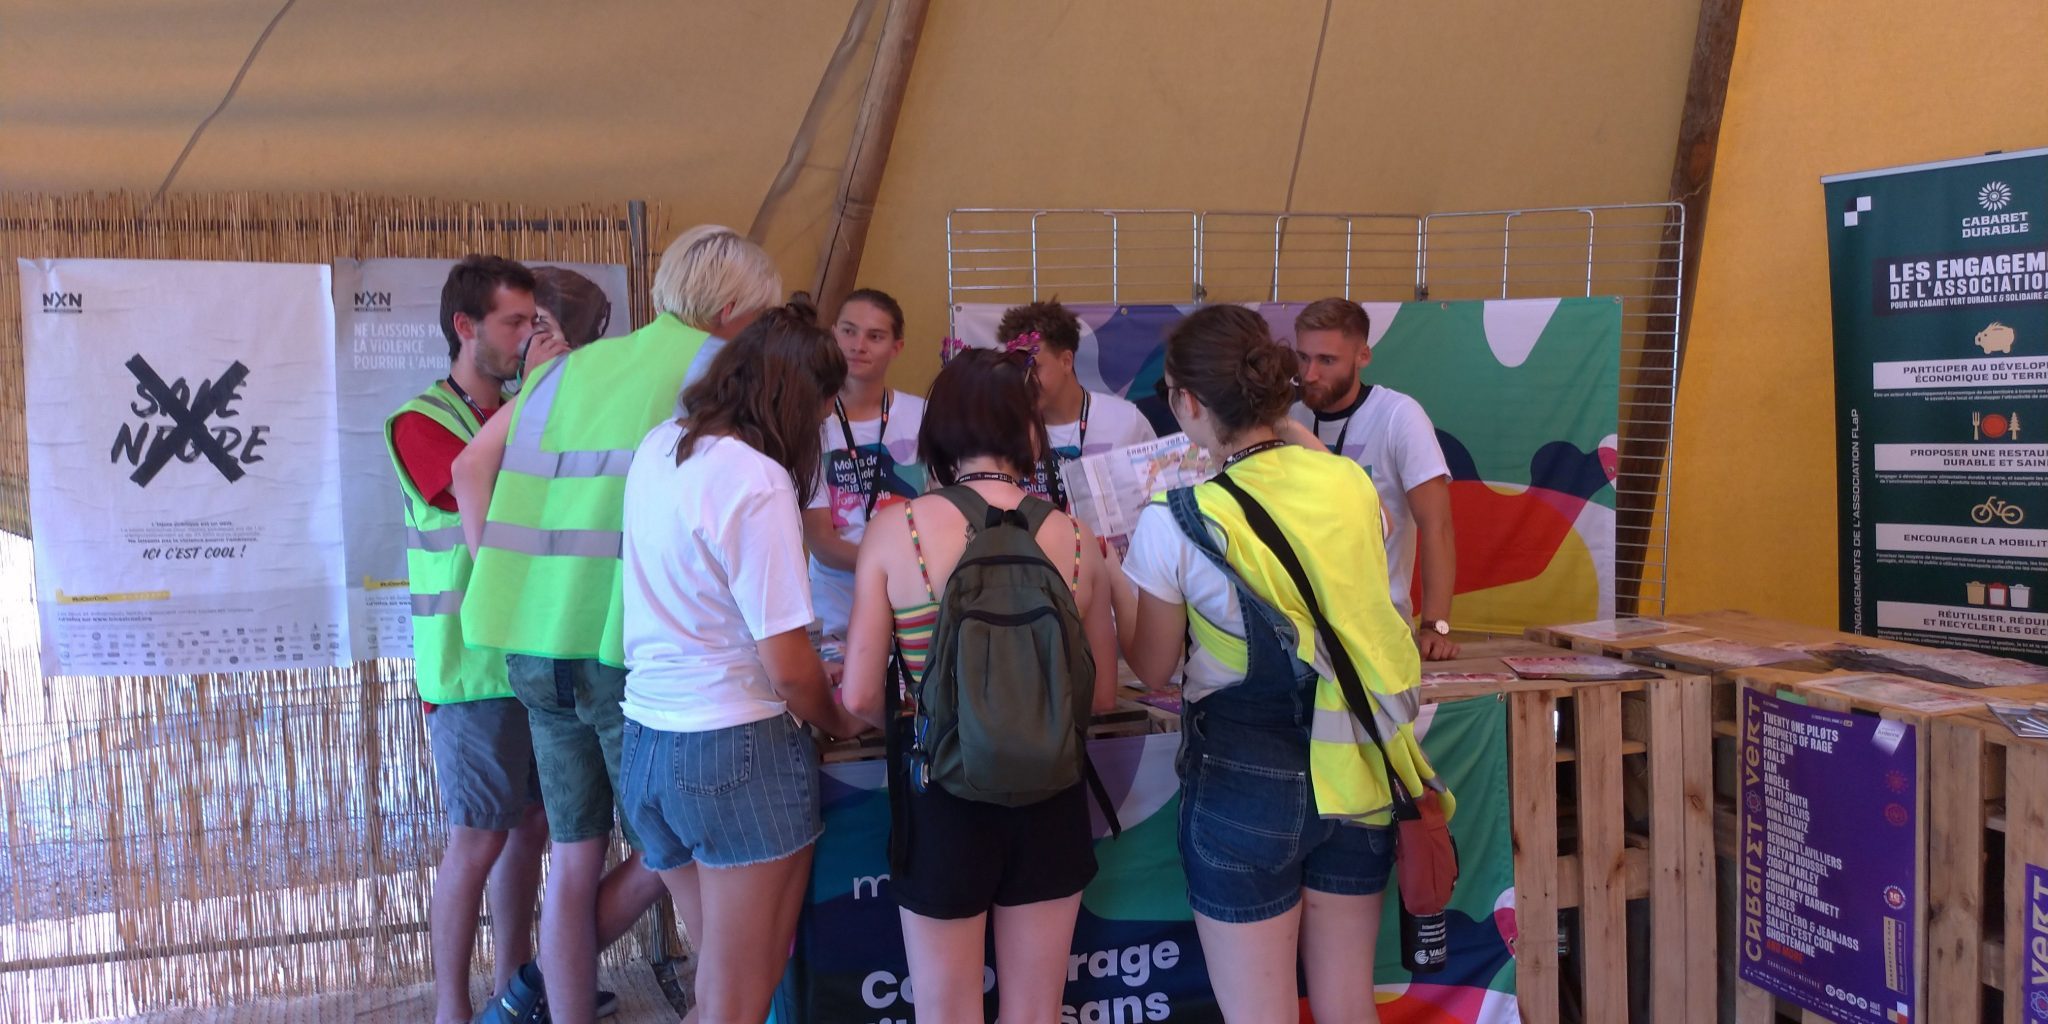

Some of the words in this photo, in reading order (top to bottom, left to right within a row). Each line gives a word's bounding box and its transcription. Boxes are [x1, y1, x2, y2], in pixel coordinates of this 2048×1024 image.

[1962, 211, 2029, 227] CABARET
[1962, 222, 2029, 239] DURABLE
[1889, 261, 1931, 283] LES
[1936, 251, 2048, 279] ENGAGEM
[1890, 283, 1910, 300] DE
[1917, 272, 2048, 298] L'ASSOCIATIO
[42, 290, 83, 309] NXN
[354, 290, 391, 308] NXN
[1890, 301, 1908, 310] POUR
[1909, 300, 1918, 308] UN
[1919, 298, 1948, 308] CABARET
[1950, 297, 1966, 306] VERT
[1967, 295, 1997, 305] DURABLE
[2005, 291, 2042, 302] SOLIDAIRE
[354, 323, 368, 337] NE
[372, 323, 425, 338] LAISSONS
[428, 323, 444, 338] PA
[354, 339, 368, 353] LA
[370, 339, 425, 354] VIOLENCE
[354, 354, 406, 370] POURRIR
[410, 355, 450, 370] L'AMBI
[1903, 364, 1968, 374] PARTICIPER
[1971, 363, 1987, 372] AU
[1990, 361, 2048, 372] DÉVELOP
[1915, 372, 1989, 383] ÉCONOMIQUE
[1992, 373, 2008, 381] DU
[1910, 449, 1968, 457] PROPOSER
[1971, 449, 1996, 457] UNE
[1999, 449, 2048, 457] RESTAU
[1943, 458, 1996, 466] DURABLE
[1999, 459, 2014, 467] ET
[2016, 459, 2048, 467] SAIN
[1852, 441, 1861, 528] L'ASSOCIATION
[1853, 530, 1861, 547] DE
[1904, 534, 1978, 544] ENCOURAGER
[1981, 538, 1996, 546] LA
[143, 547, 161, 560] ICI
[165, 547, 201, 560] C'EST
[205, 546, 236, 559] COOL
[1854, 549, 1862, 636] ENGAGEMENTS
[1923, 619, 1936, 627] ET
[1940, 619, 1996, 632] RECYCLER
[1999, 625, 2021, 634] LES
[2009, 615, 2048, 627] RÉDUI
[1763, 711, 1790, 730] TWENTY
[1763, 723, 1798, 745] PROPHETS
[1799, 735, 1809, 748] OF
[1810, 738, 1833, 754] RAGE
[1763, 735, 1794, 756] ORELSAN
[1763, 748, 1785, 765] FOALS
[1764, 760, 1777, 774] IAM
[1765, 784, 1784, 802] PATTI
[1785, 789, 1808, 809] SMITH
[1790, 802, 1810, 822] ELVIS
[1767, 820, 1805, 844] AIRBOURNE
[1783, 813, 1808, 834] KRAVIZ
[1767, 831, 1799, 853] BERNARD
[1800, 843, 1842, 870] LAVILLIERS
[1766, 855, 1788, 872] ZIGGY
[1789, 863, 1819, 885] MARLEY
[1796, 854, 1829, 878] ROUSSEL
[1766, 867, 1795, 889] JOHNNY
[1796, 879, 1818, 897] MARR
[1766, 879, 1804, 904] COURTNEY
[1805, 896, 1839, 919] BARNETT
[1766, 891, 1776, 903] OH
[1777, 894, 1795, 912] SEES
[1766, 902, 1808, 929] CABALLERO
[1809, 921, 1816, 933] &
[1816, 924, 1859, 951] JEANJASS
[1766, 914, 1789, 935] SALUT
[1790, 925, 1812, 943] C'EST
[1813, 934, 1835, 954] COOL
[1766, 926, 1816, 958] GHOSTEMANE
